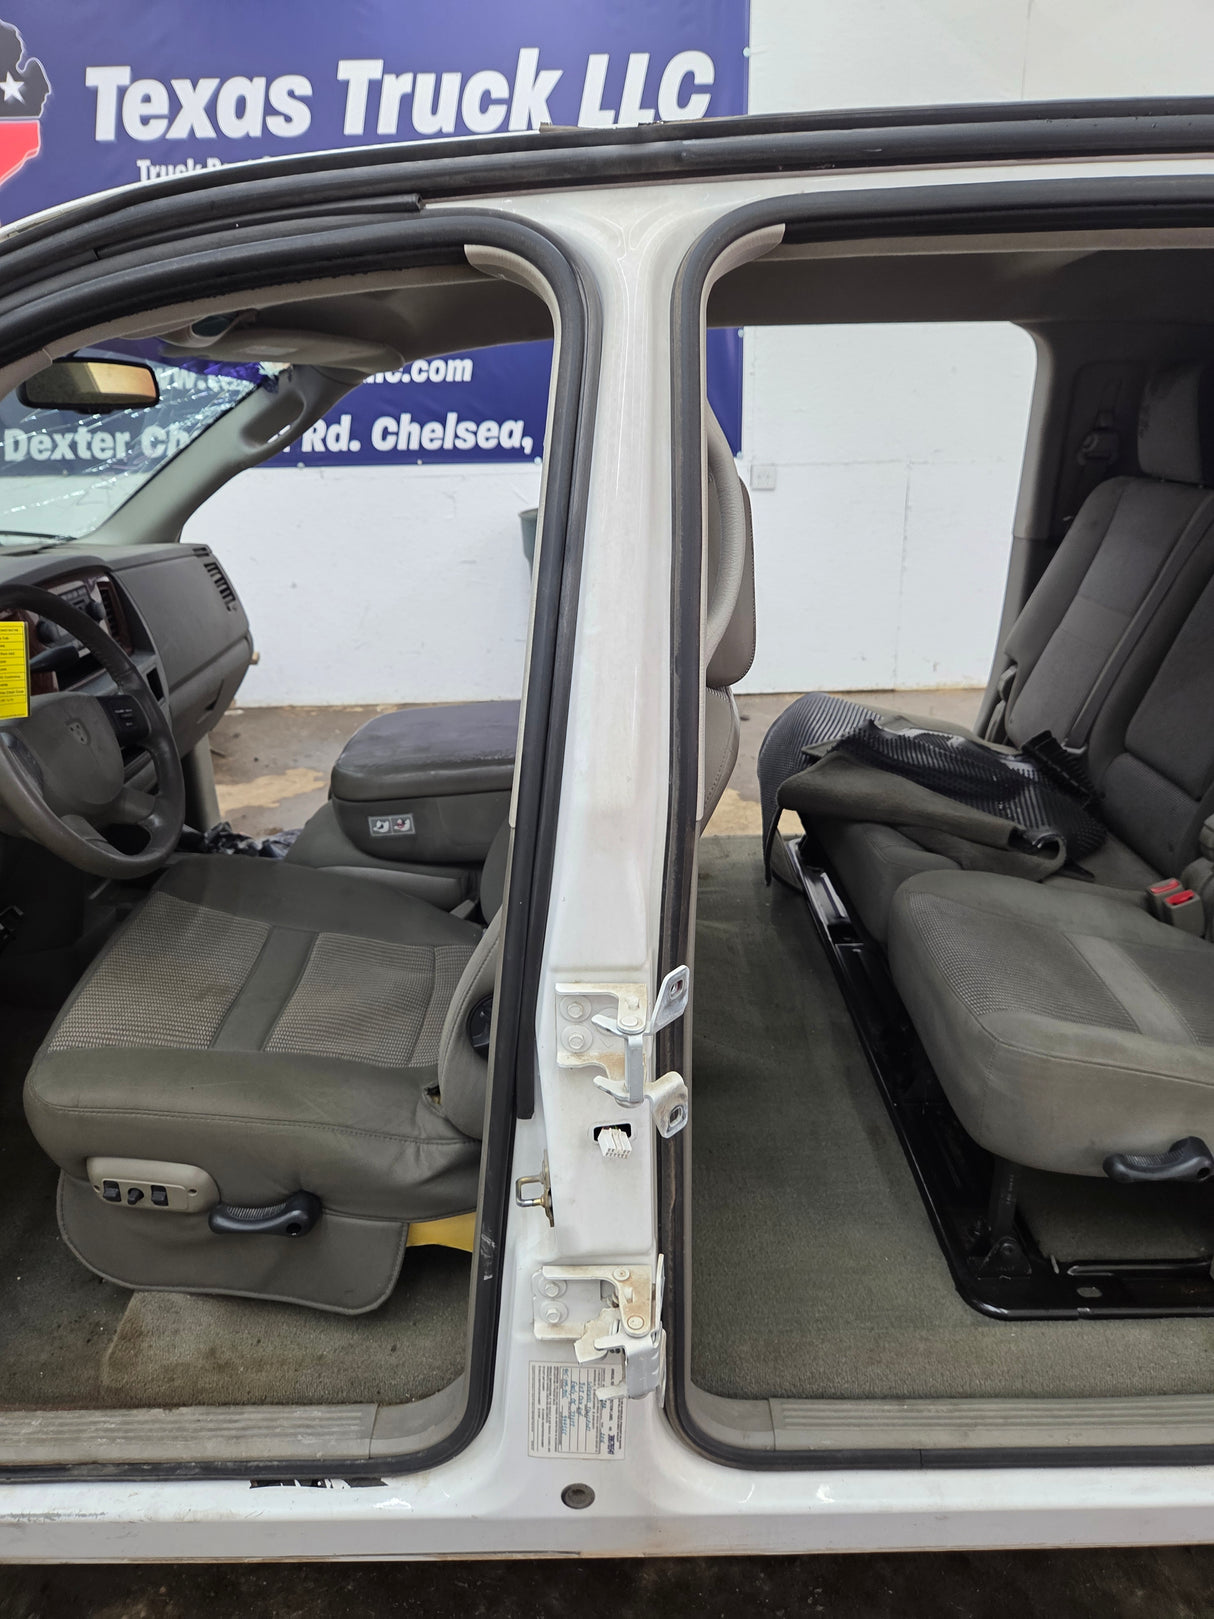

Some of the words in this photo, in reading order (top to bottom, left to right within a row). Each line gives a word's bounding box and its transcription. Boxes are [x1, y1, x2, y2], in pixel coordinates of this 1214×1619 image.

[85, 65, 313, 141] Texas
[337, 47, 564, 135] Truck
[577, 50, 715, 126] LLC
[4, 426, 131, 462] Dexter
[301, 413, 361, 452] Rd.
[371, 412, 534, 454] Chelsea,
